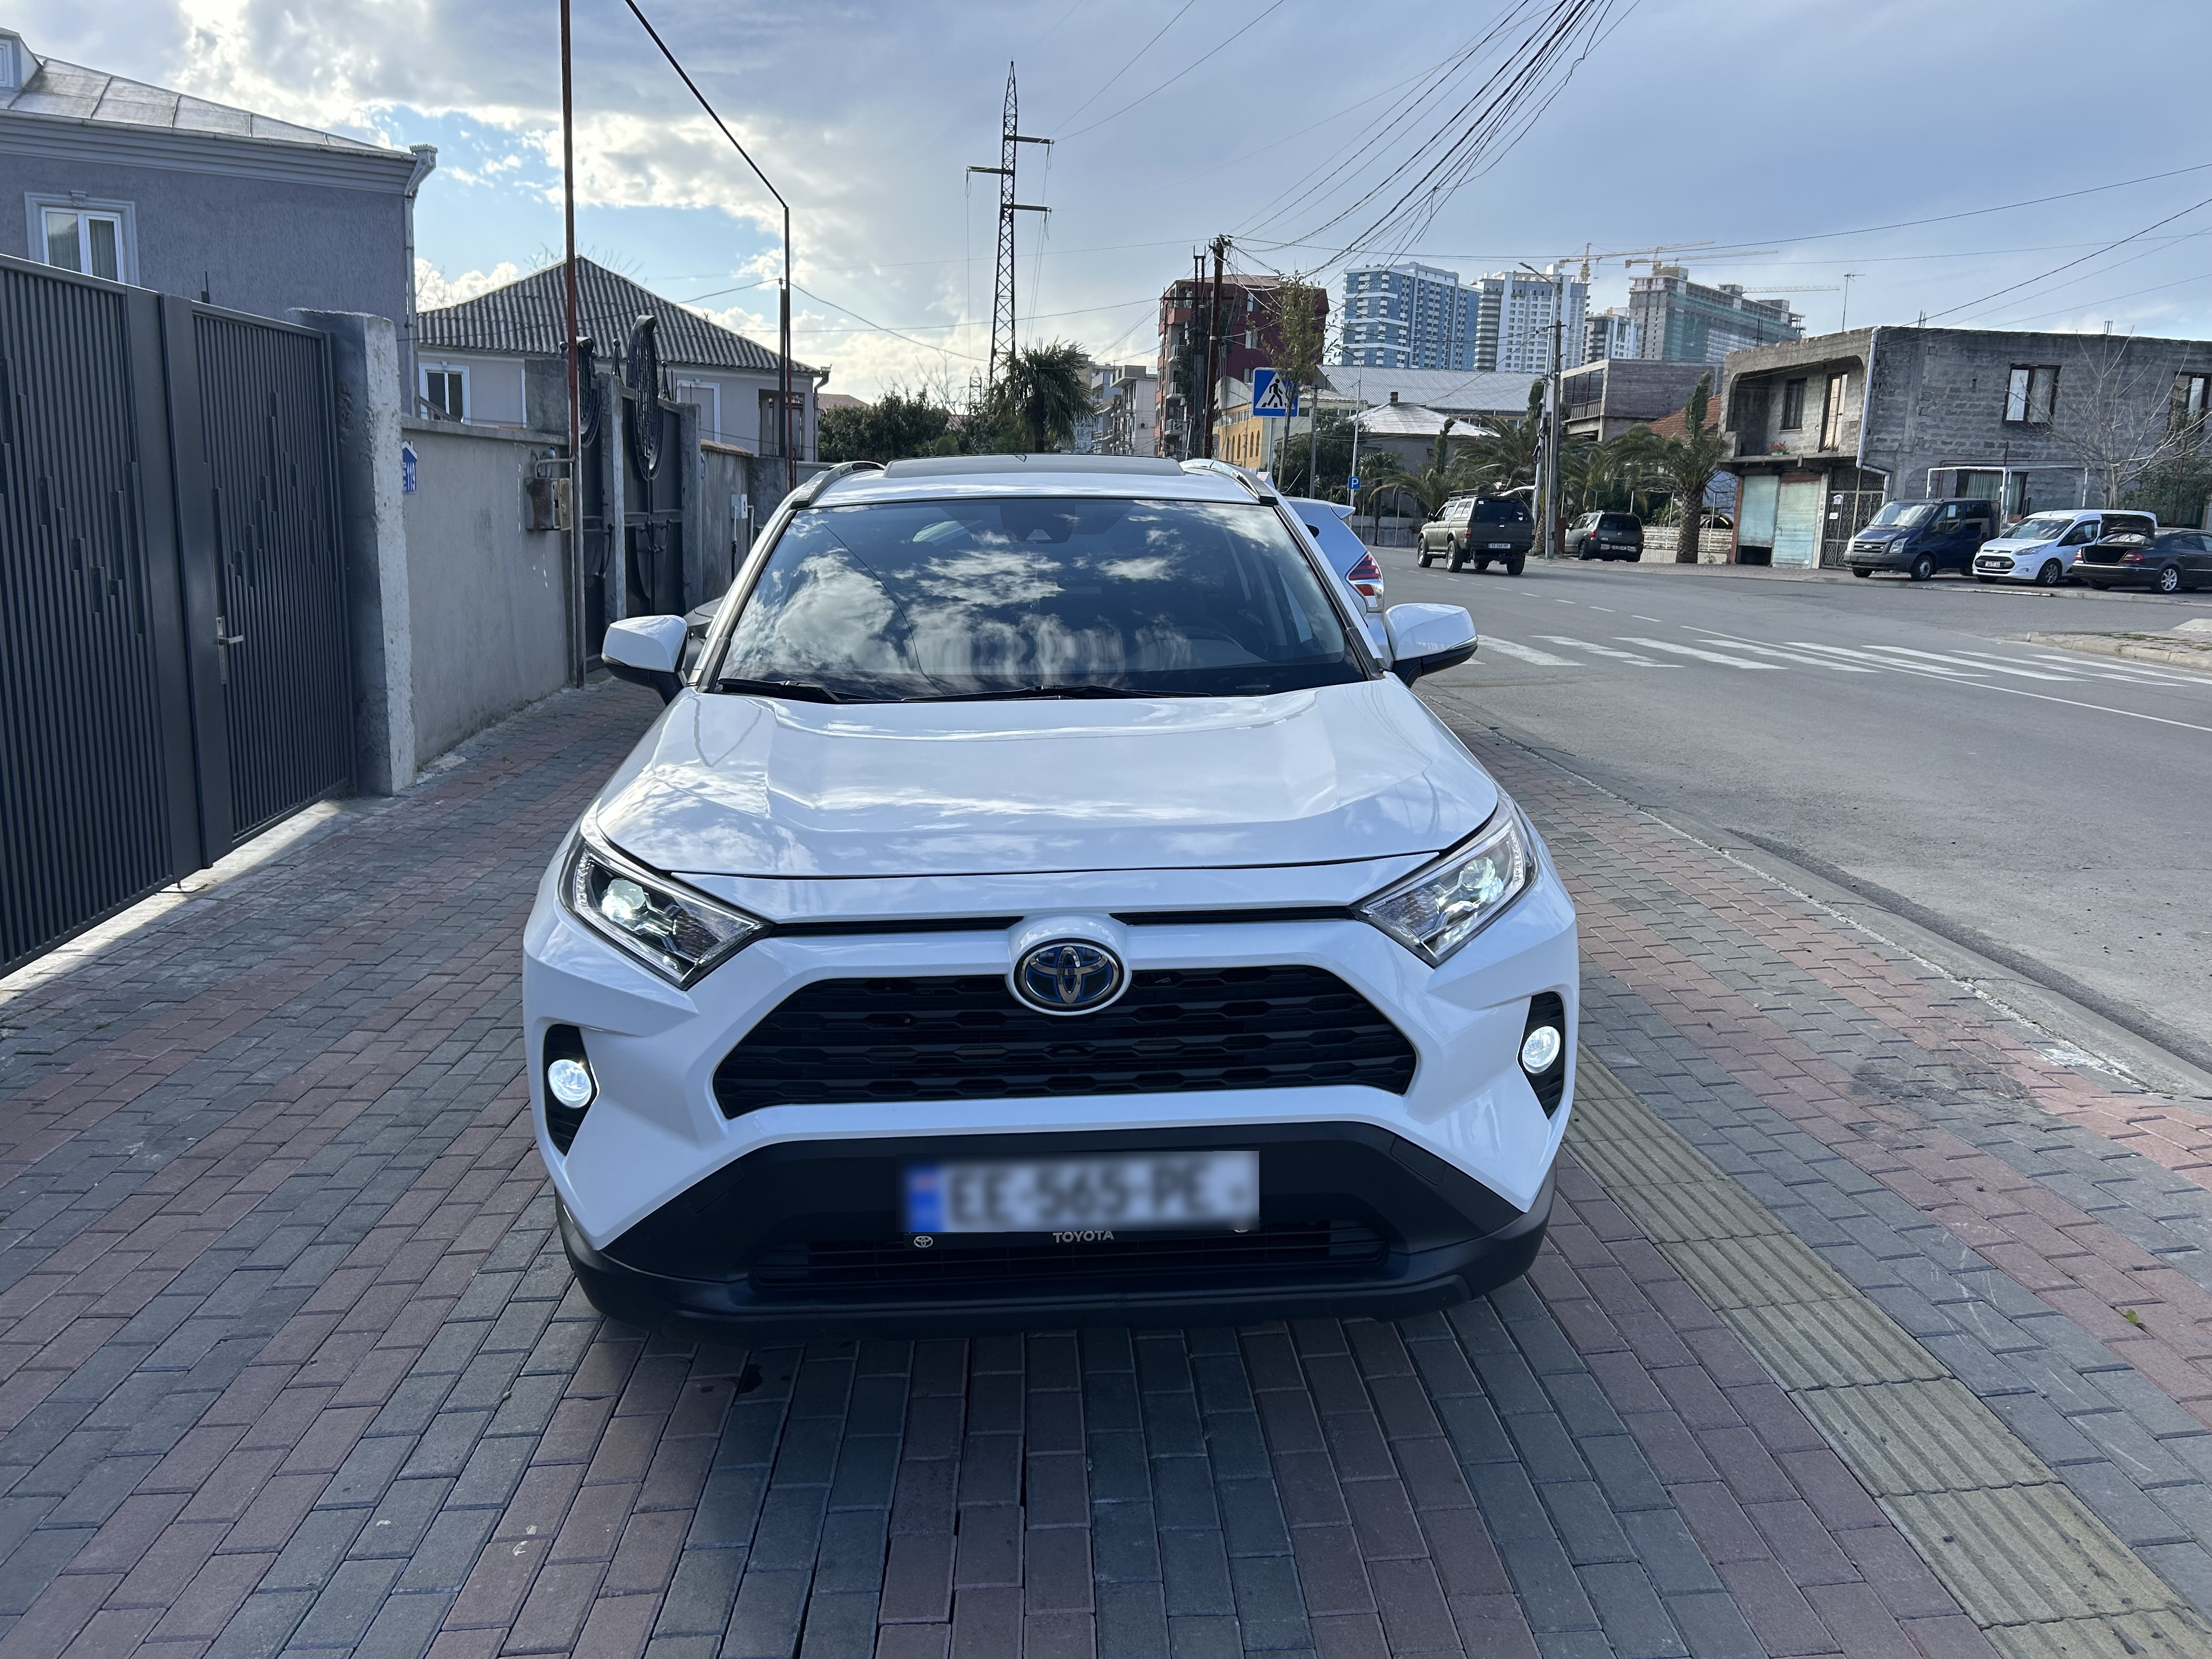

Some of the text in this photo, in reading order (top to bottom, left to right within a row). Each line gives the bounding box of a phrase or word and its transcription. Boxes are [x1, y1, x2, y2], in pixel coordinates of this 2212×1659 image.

[407, 461, 415, 491] 119
[1351, 478, 1359, 488] P
[1053, 1231, 1114, 1243] TOYOTA
